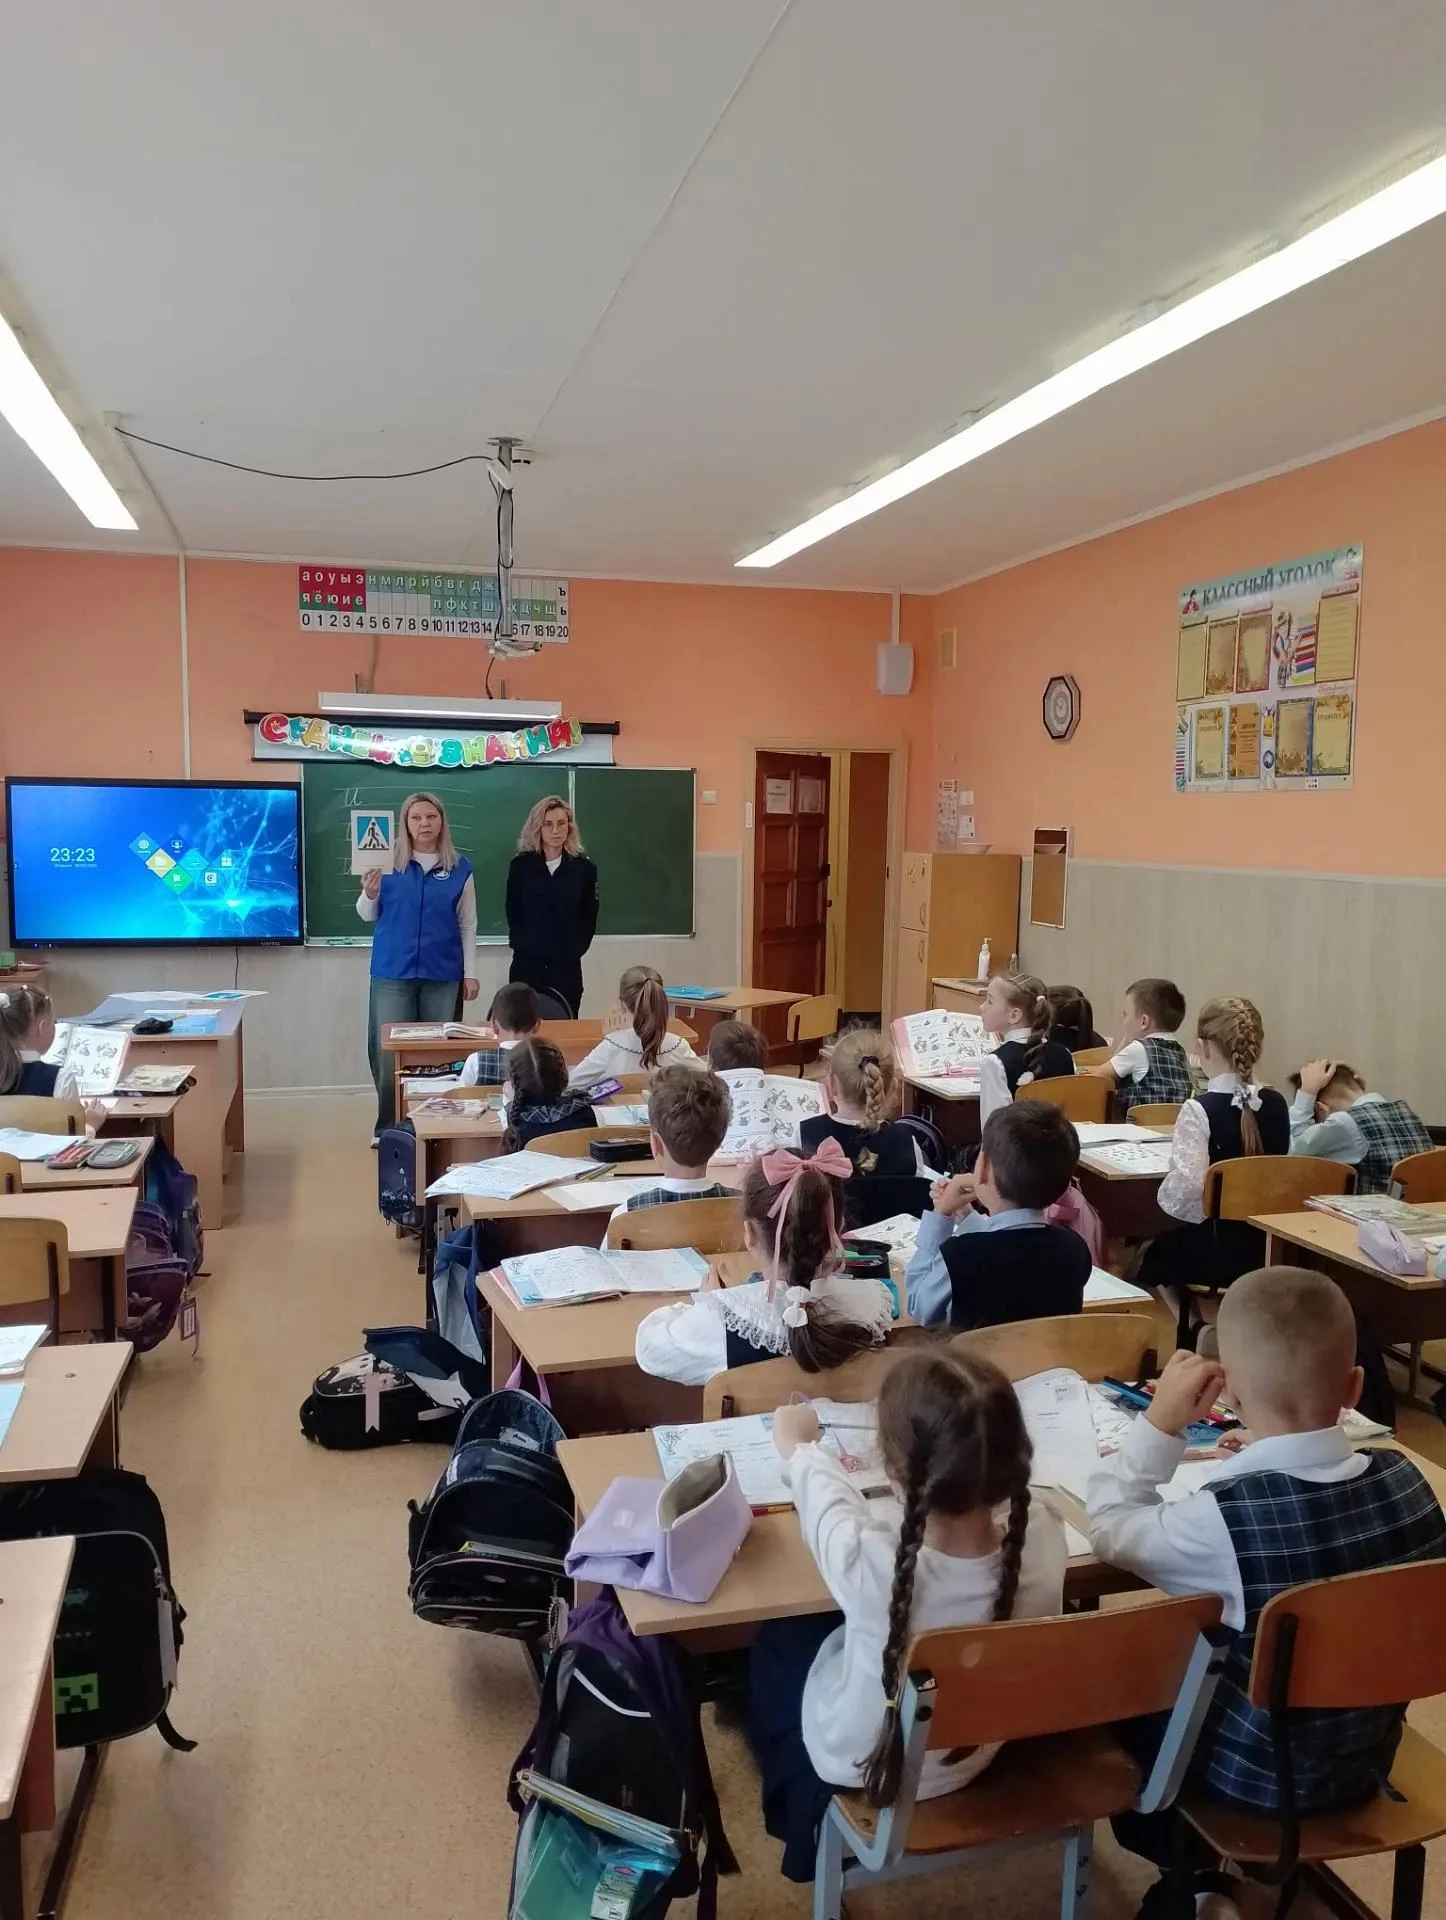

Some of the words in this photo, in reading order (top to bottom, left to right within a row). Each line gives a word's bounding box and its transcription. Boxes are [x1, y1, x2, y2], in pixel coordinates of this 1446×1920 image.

[303, 571, 310, 581] а
[315, 572, 323, 582] о
[328, 572, 336, 585] у
[341, 574, 351, 584] ы
[356, 574, 364, 584] э
[369, 575, 376, 585] н
[382, 576, 391, 585] м
[395, 576, 404, 586] л
[408, 577, 417, 590] р
[422, 575, 429, 587] й
[435, 576, 442, 588] б
[447, 579, 454, 589] в
[472, 581, 481, 591] д
[484, 582, 495, 591] ж
[558, 587, 566, 596] ъ
[1202, 567, 1275, 607] КЛАССНЫЙ
[1277, 558, 1336, 588] УГОЛОК
[303, 593, 310, 602] я
[315, 590, 322, 603] ё
[327, 594, 339, 604] ю
[342, 595, 351, 605] и
[355, 596, 364, 605] е
[433, 600, 441, 609] п
[447, 597, 457, 612] ф
[461, 601, 468, 610] к
[483, 602, 494, 612] ш
[521, 604, 530, 615] ц
[545, 604, 557, 615] щ
[560, 606, 567, 615] ь
[302, 613, 310, 625] 0
[317, 614, 323, 626] 1
[330, 615, 338, 627] 2
[343, 615, 351, 627] 3
[355, 616, 364, 628] 4
[369, 617, 377, 629] 5
[382, 617, 390, 629] 6
[395, 618, 404, 630] 7
[408, 618, 416, 630] 8
[421, 619, 429, 631] 9
[433, 620, 443, 632] 10
[446, 621, 455, 632] 11
[459, 621, 468, 633] 12
[470, 622, 481, 633] 13
[482, 622, 492, 634] 14
[521, 624, 530, 635] 17
[534, 625, 544, 636] 18
[545, 625, 555, 637] 19
[558, 626, 568, 637] 20
[259, 713, 289, 744] С
[50, 847, 95, 862] 23:23
